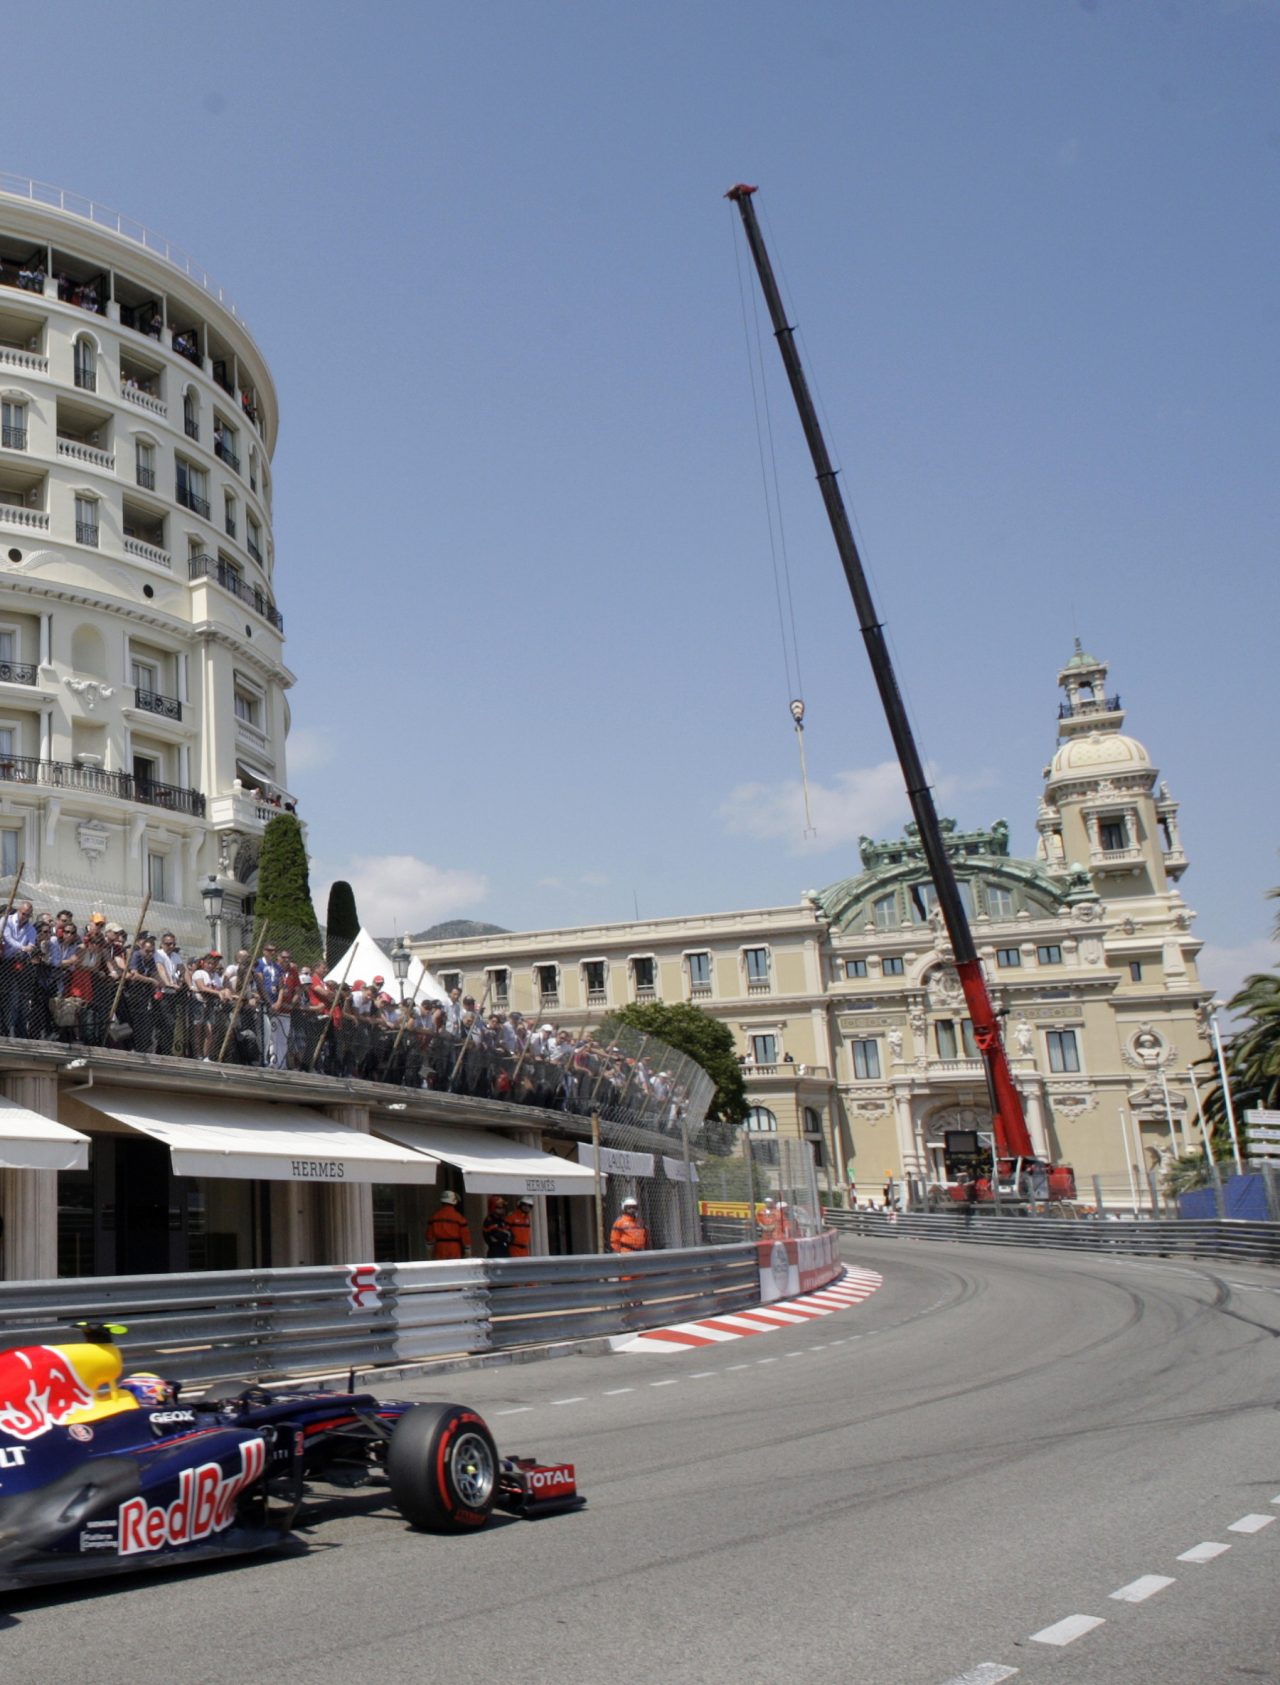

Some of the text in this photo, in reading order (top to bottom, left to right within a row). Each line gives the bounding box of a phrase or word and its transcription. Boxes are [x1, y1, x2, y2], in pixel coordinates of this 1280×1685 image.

[149, 1409, 195, 1425] GEOX
[526, 1470, 574, 1488] TOTAL
[118, 1437, 265, 1556] Red Bull
